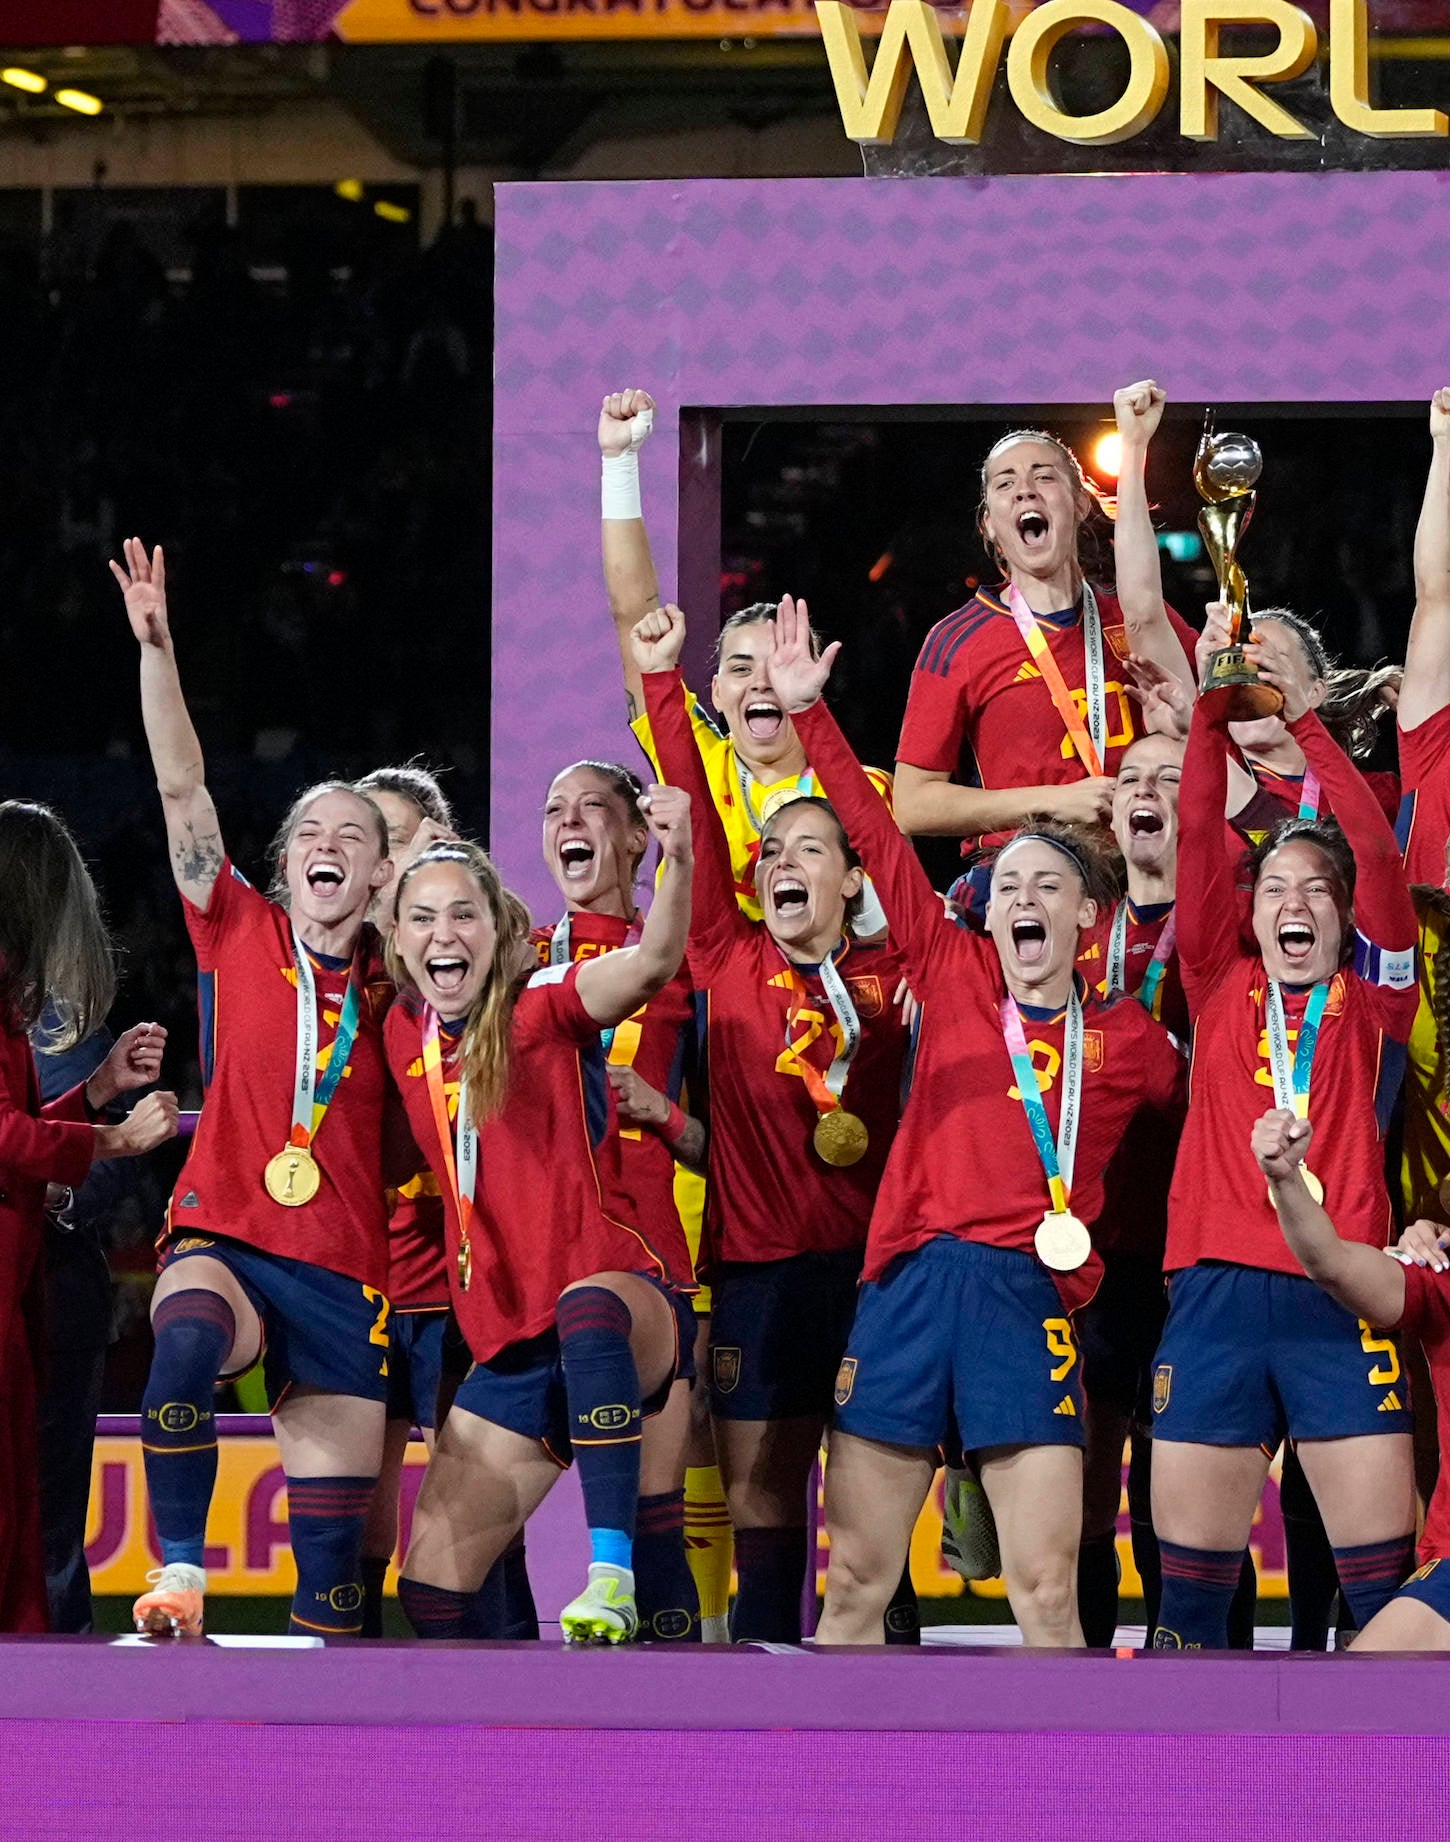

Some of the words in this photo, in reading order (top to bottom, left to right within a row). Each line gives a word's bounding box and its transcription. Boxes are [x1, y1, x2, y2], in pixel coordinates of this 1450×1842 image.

[1217, 654, 1245, 667] FIF
[1069, 1041, 1078, 1069] WORLD
[1273, 1033, 1283, 1058] WORLD
[1007, 1039, 1061, 1101] 9
[1069, 1070, 1077, 1087] CUP
[1276, 1059, 1285, 1076] CUP
[362, 1284, 390, 1348] 2
[1042, 1317, 1077, 1381] 9
[1358, 1318, 1400, 1386] 5
